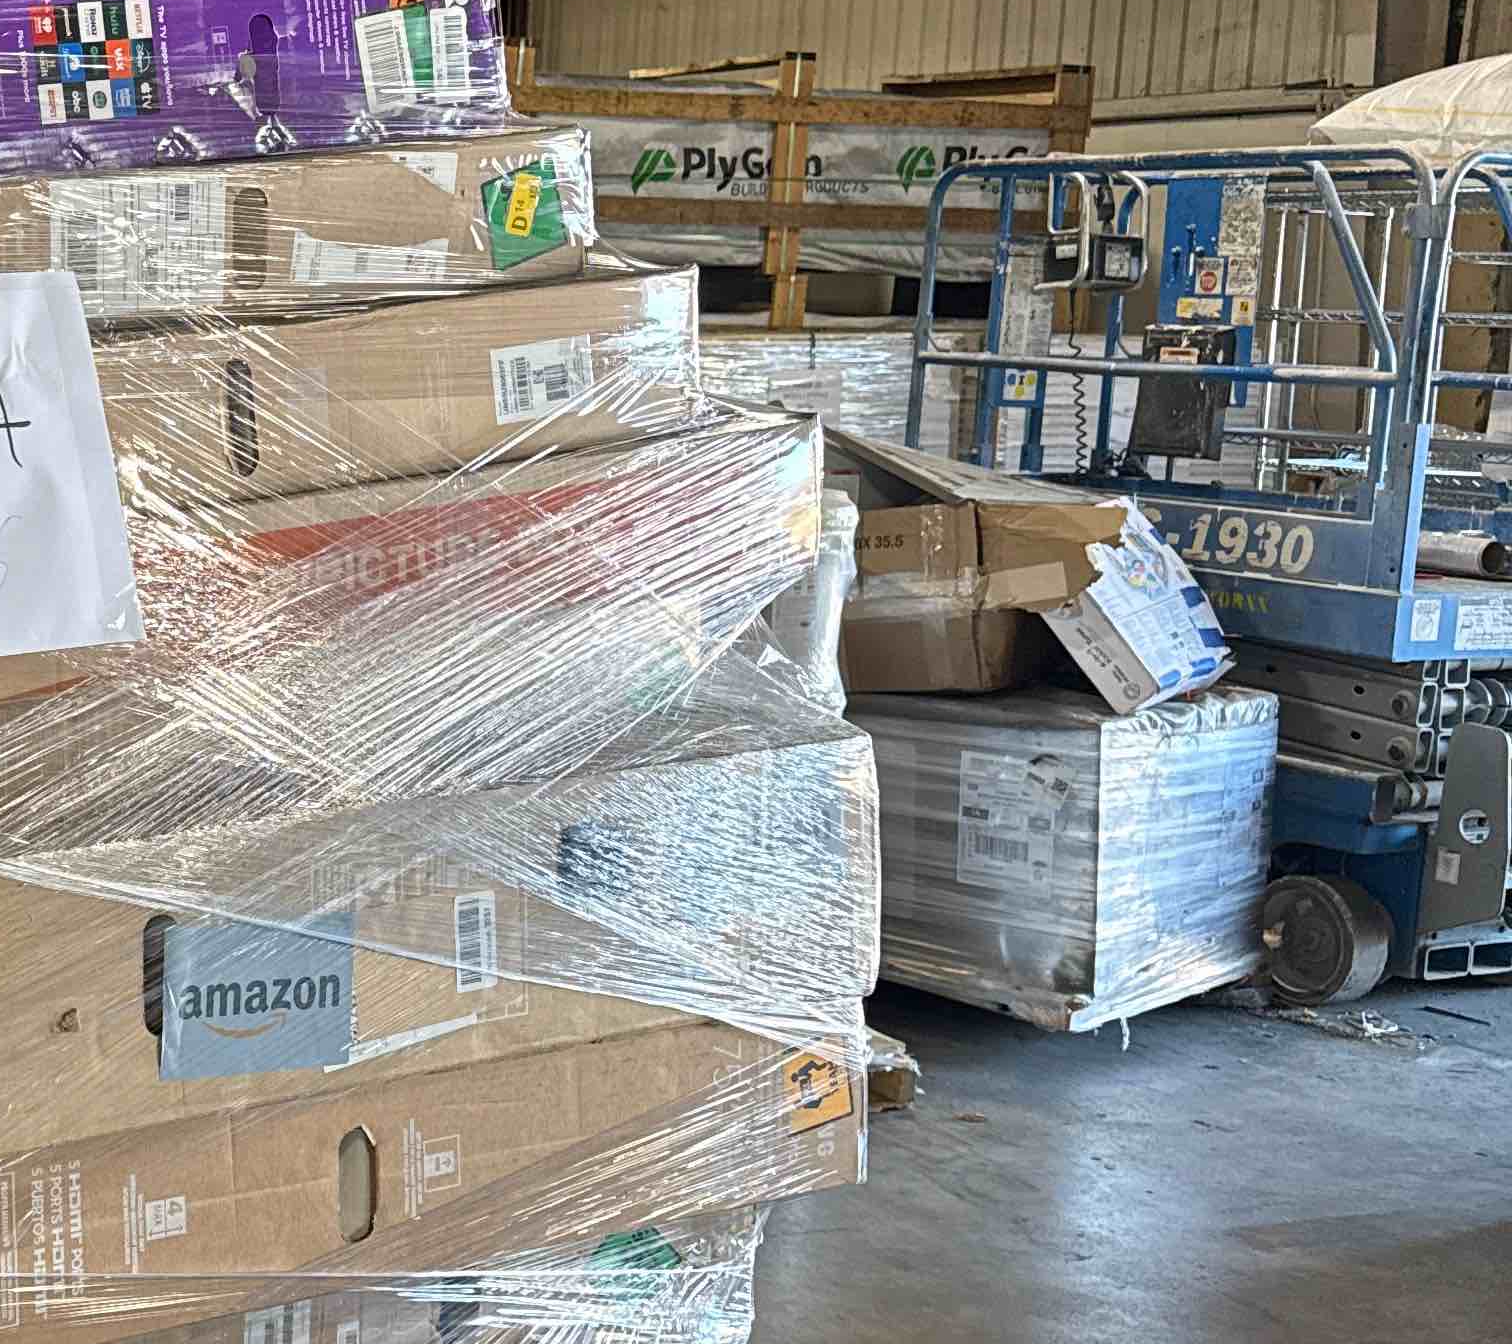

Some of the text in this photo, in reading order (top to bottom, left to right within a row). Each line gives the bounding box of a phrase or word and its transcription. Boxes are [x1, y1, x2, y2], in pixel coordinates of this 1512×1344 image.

[109, 6, 120, 36] hulu
[511, 216, 528, 232] D
[178, 972, 341, 1021] amazon
[32, 1179, 46, 1245] PUERTOS
[50, 1175, 65, 1225] PORTS
